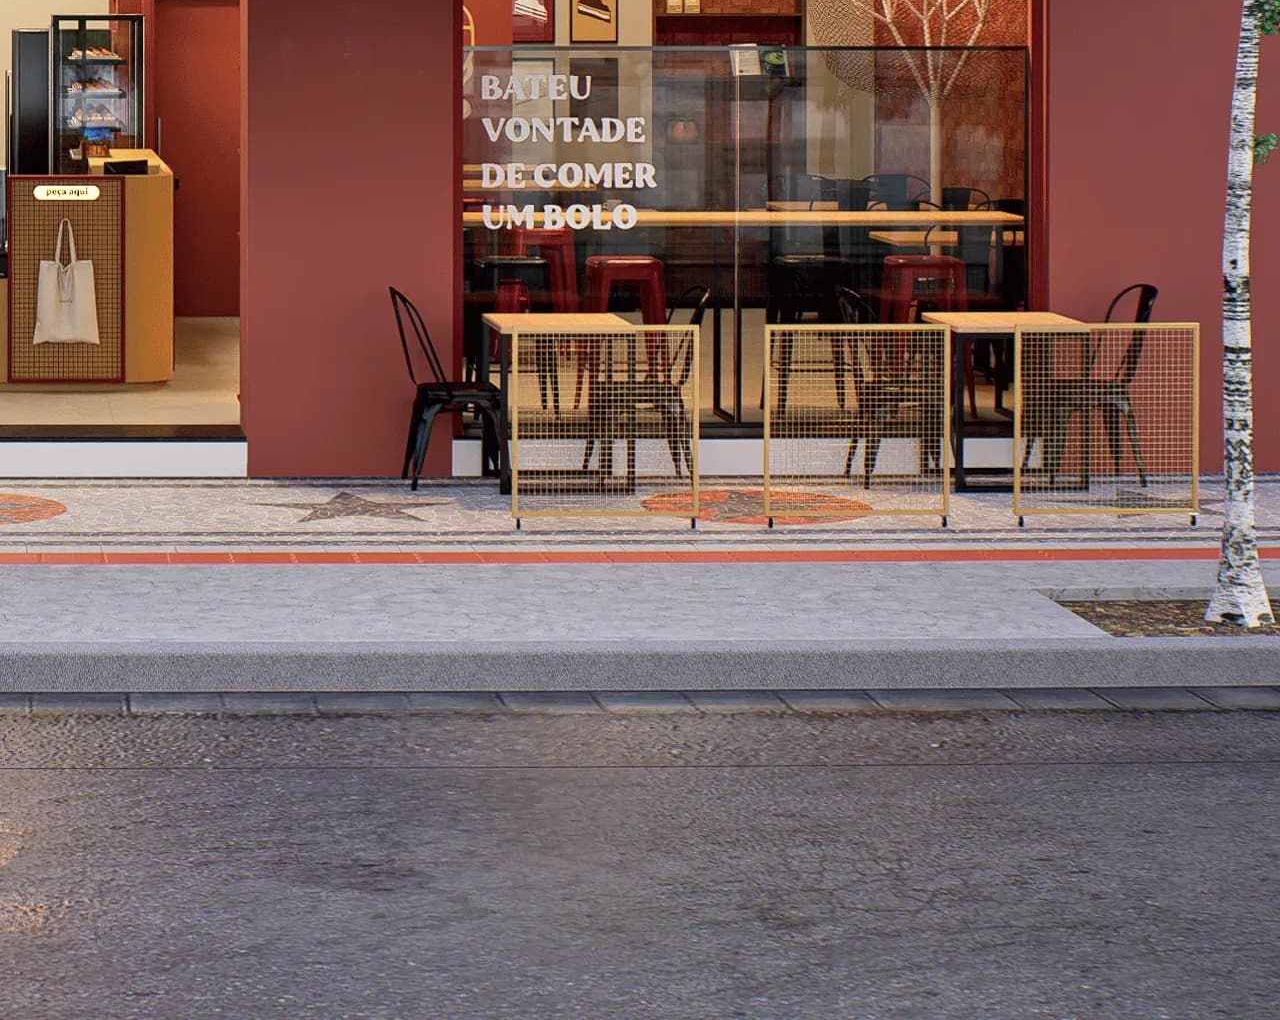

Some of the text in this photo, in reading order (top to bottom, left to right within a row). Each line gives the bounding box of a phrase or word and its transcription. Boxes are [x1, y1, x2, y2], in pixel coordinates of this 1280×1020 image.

[481, 75, 592, 101] BATEU
[481, 117, 646, 143] VONTADE
[481, 162, 658, 189] DE COMER
[69, 187, 88, 197] aqui
[482, 204, 638, 230] UM BOLO
